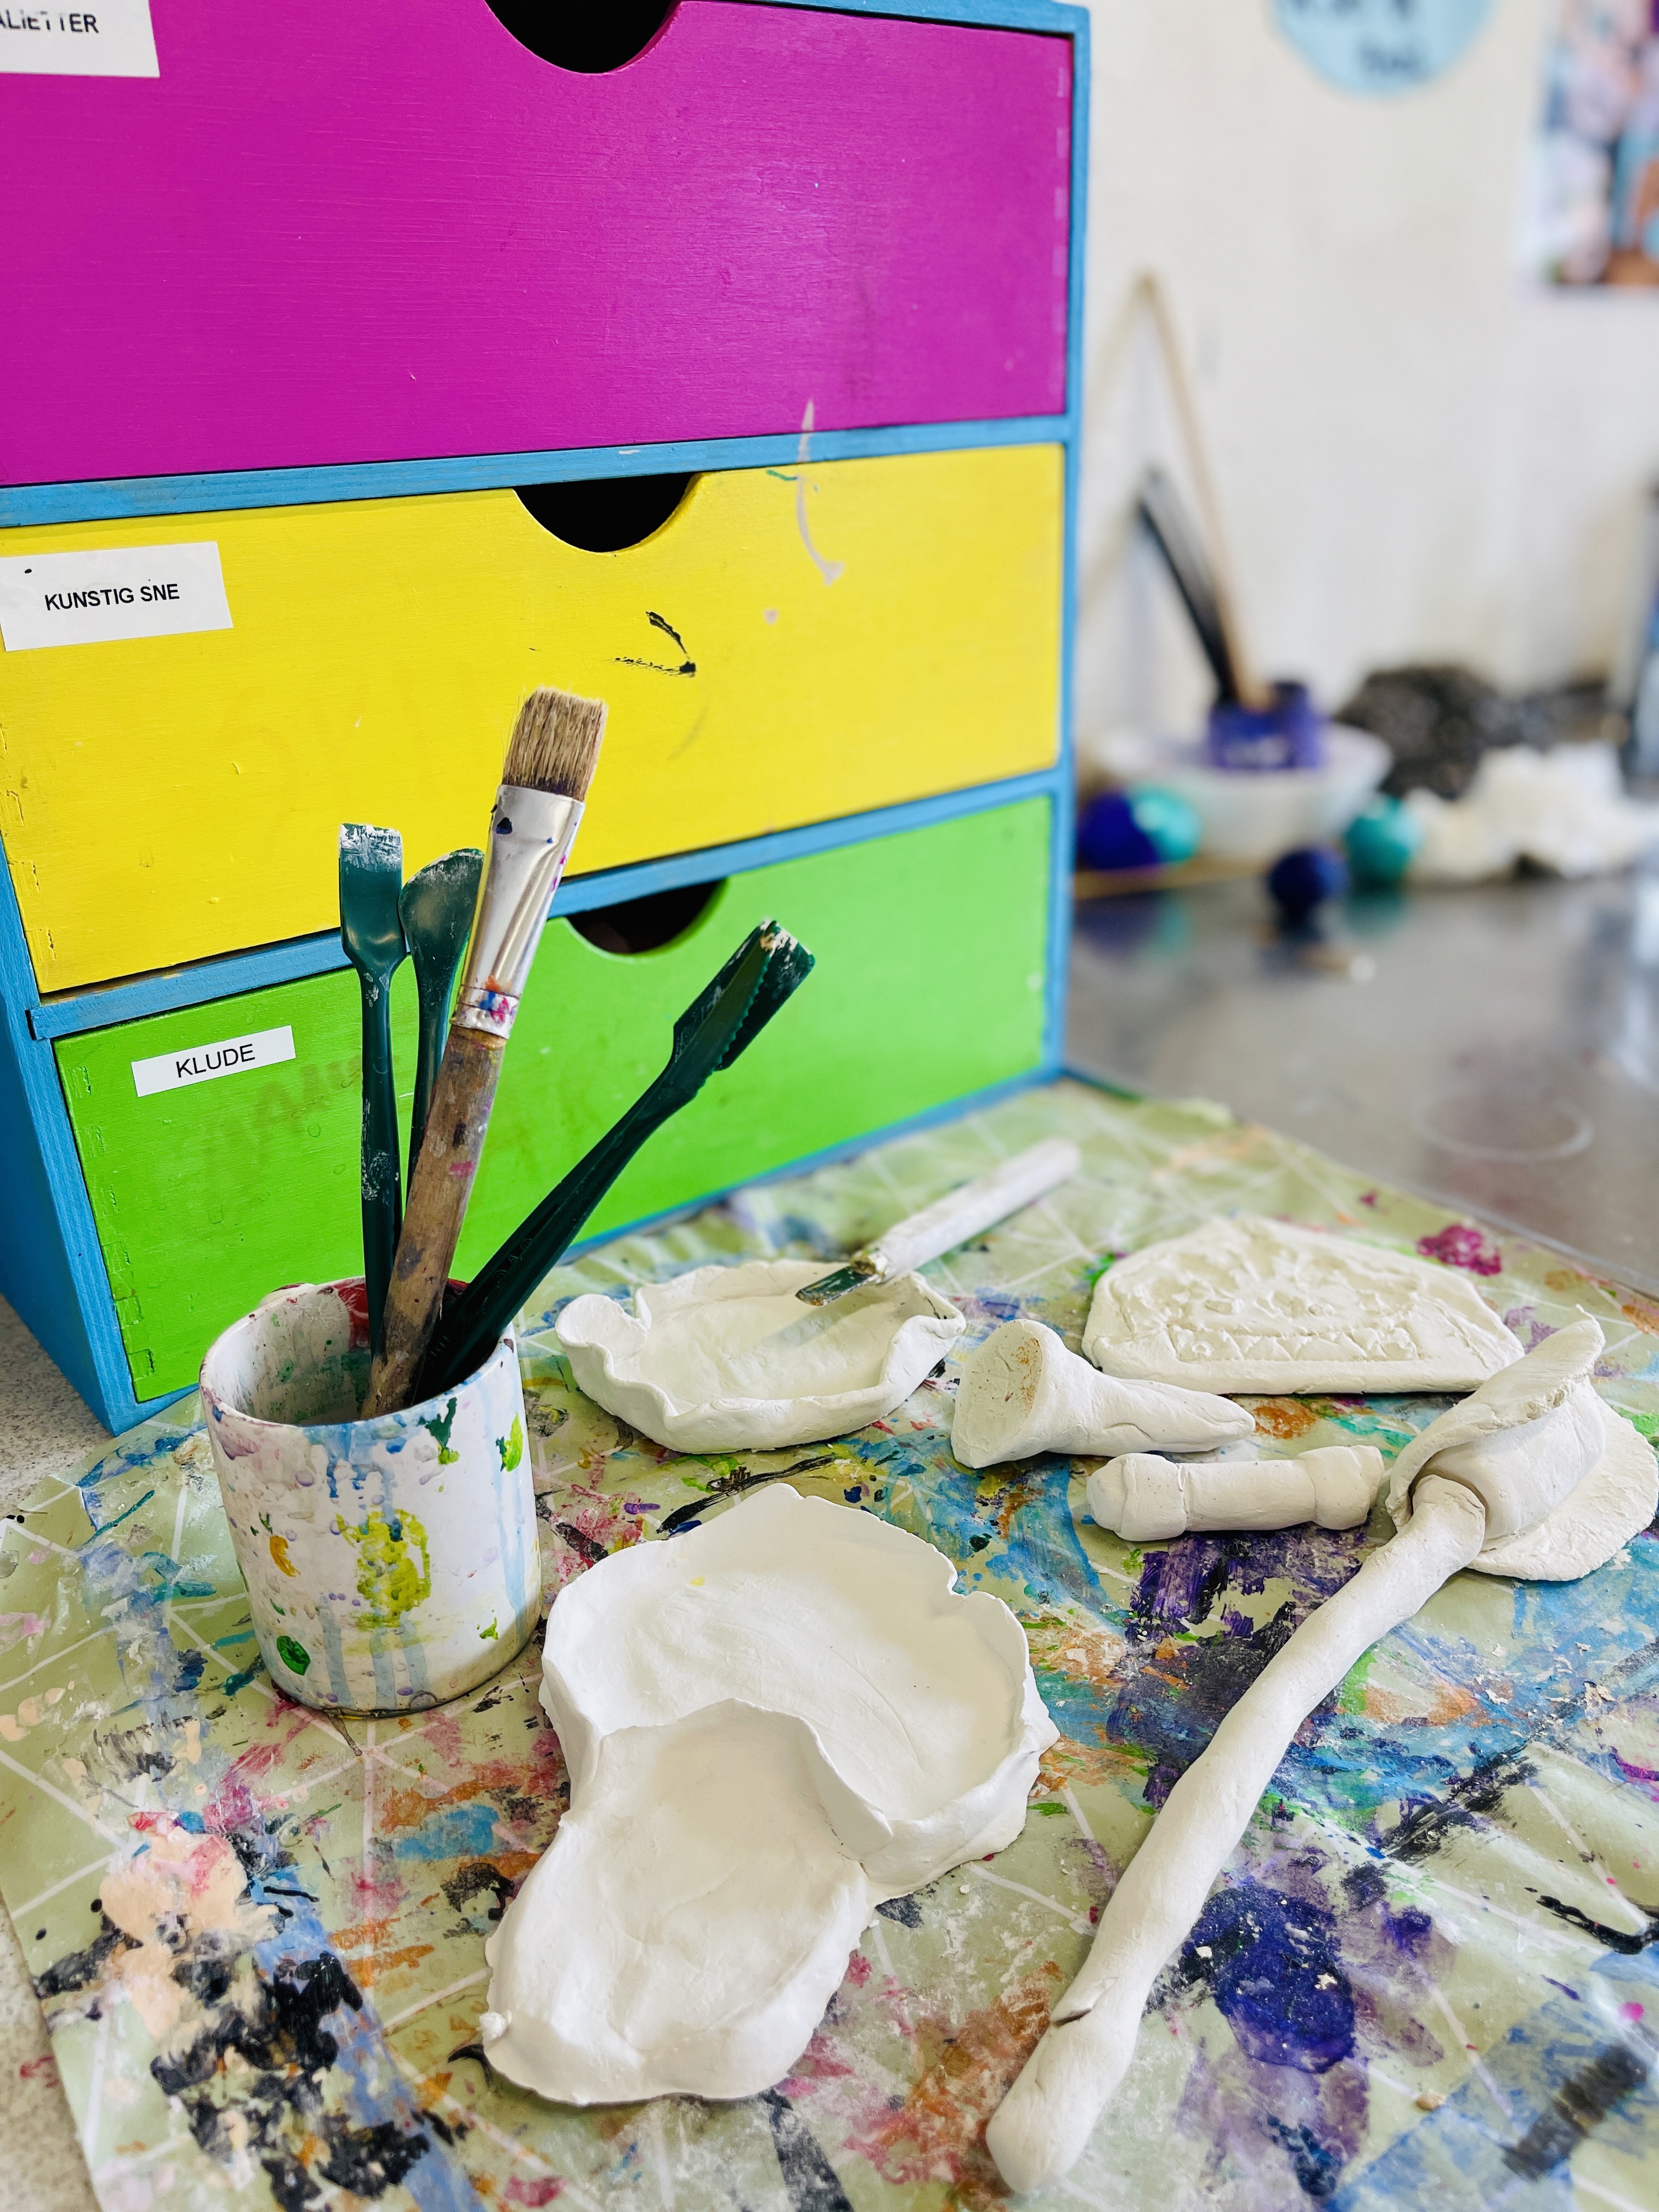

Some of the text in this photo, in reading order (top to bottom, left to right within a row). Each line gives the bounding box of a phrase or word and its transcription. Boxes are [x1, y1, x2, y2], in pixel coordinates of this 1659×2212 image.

[45, 583, 180, 611] KUNSTIG SNE
[176, 1043, 256, 1078] KLUDE
